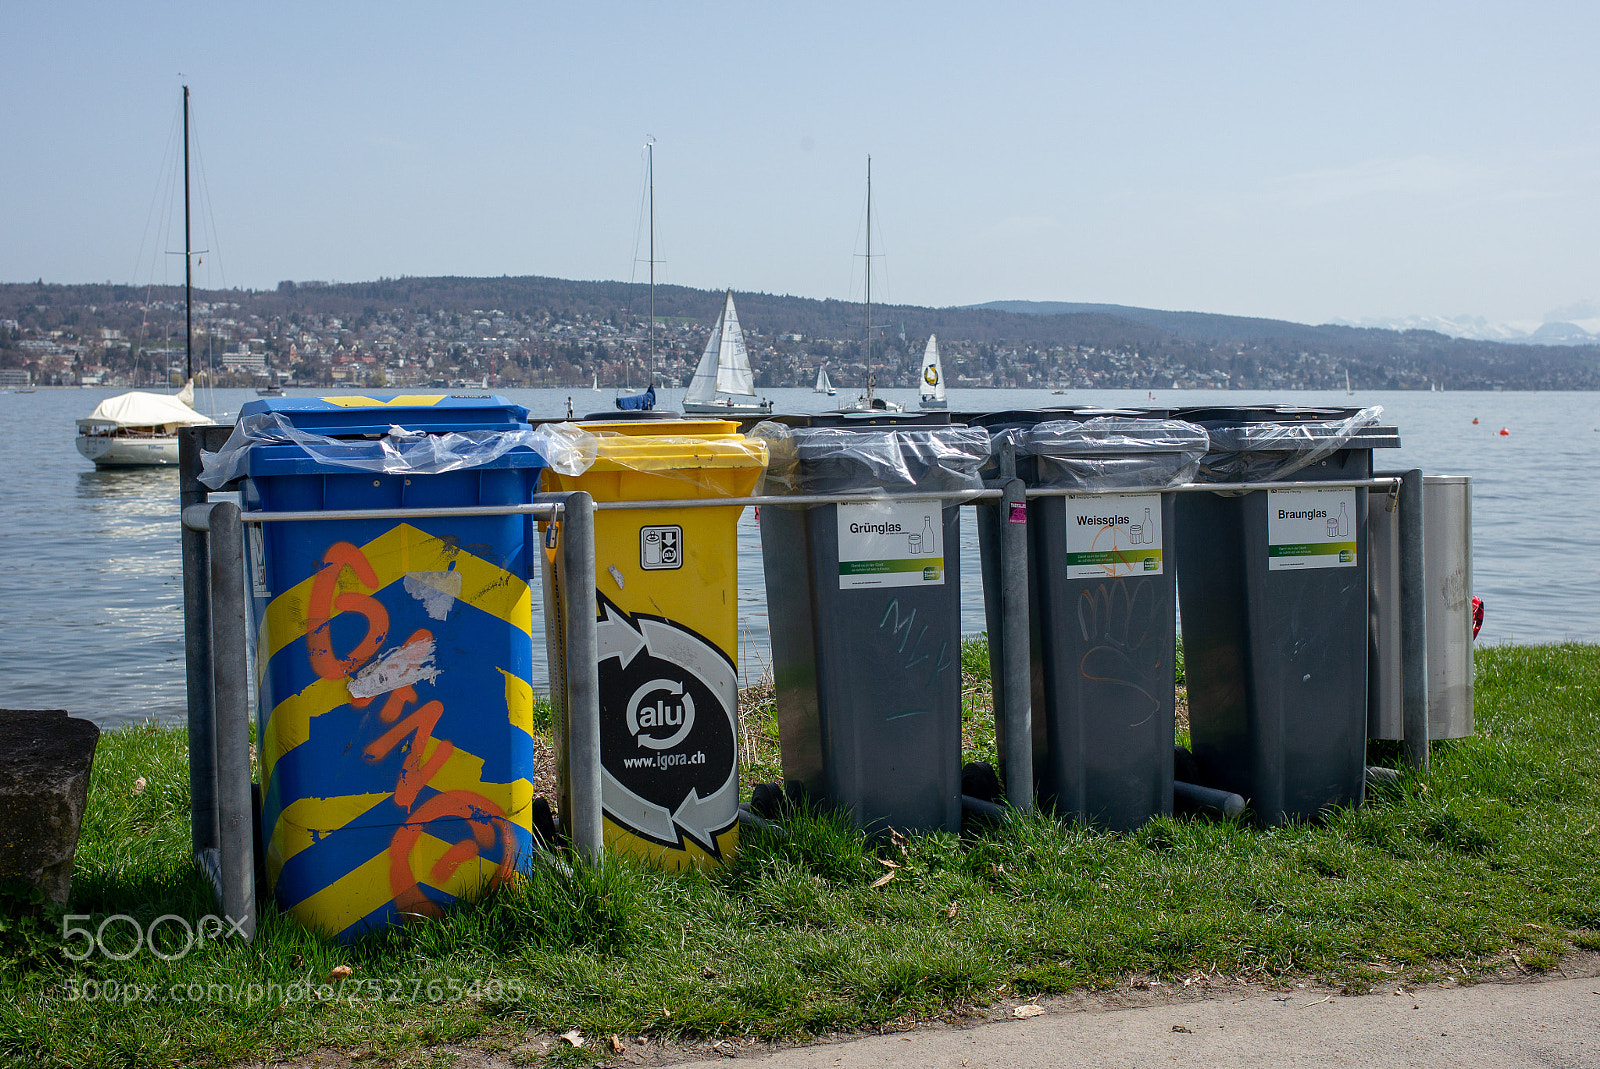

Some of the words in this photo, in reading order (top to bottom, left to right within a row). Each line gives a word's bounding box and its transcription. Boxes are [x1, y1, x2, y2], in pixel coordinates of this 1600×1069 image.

[1278, 508, 1327, 520] Braunglas
[1076, 515, 1130, 527] Weissglas
[849, 522, 902, 535] Grünglas
[639, 700, 682, 728] alu
[623, 750, 706, 770] www.igora.ch
